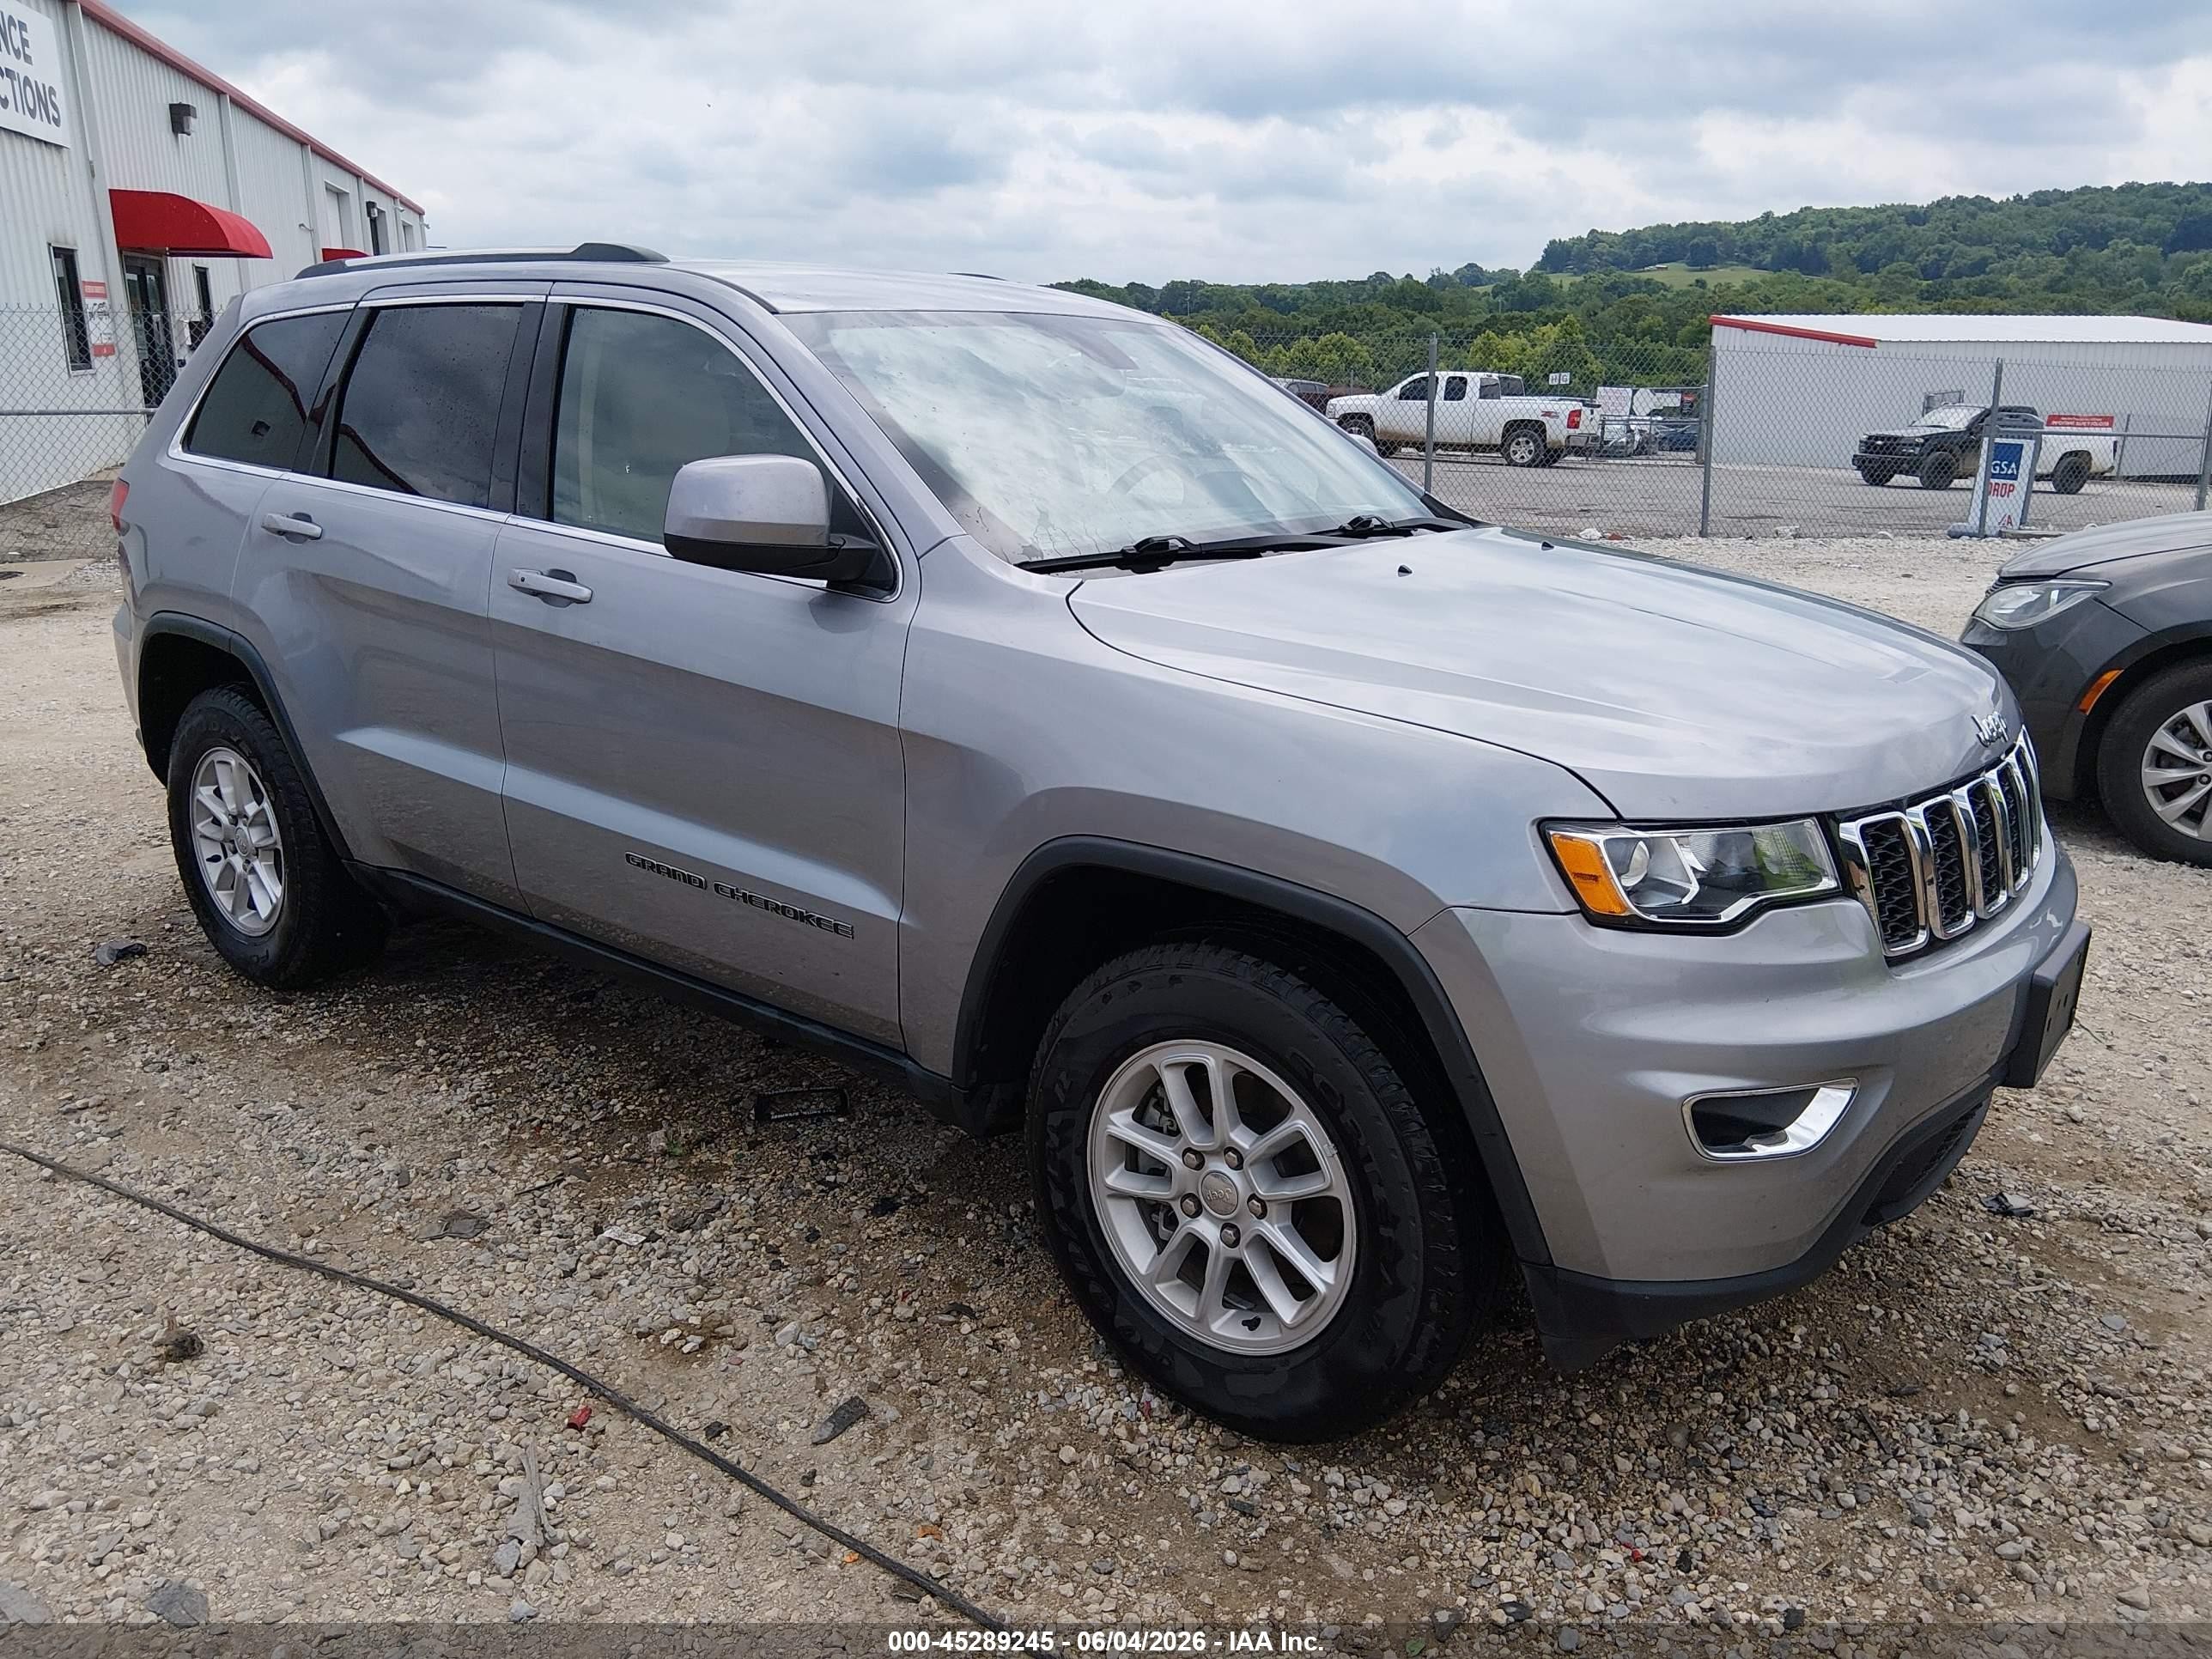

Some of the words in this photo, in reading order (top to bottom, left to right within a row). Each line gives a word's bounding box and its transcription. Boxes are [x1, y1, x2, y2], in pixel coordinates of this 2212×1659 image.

[1551, 375, 1558, 384] H
[1990, 460, 2017, 475] GSA
[1971, 711, 2008, 747] Jeep
[624, 851, 708, 890] GRAND
[714, 881, 854, 940] CHEROKEE
[1206, 1188, 1232, 1202] Jeep
